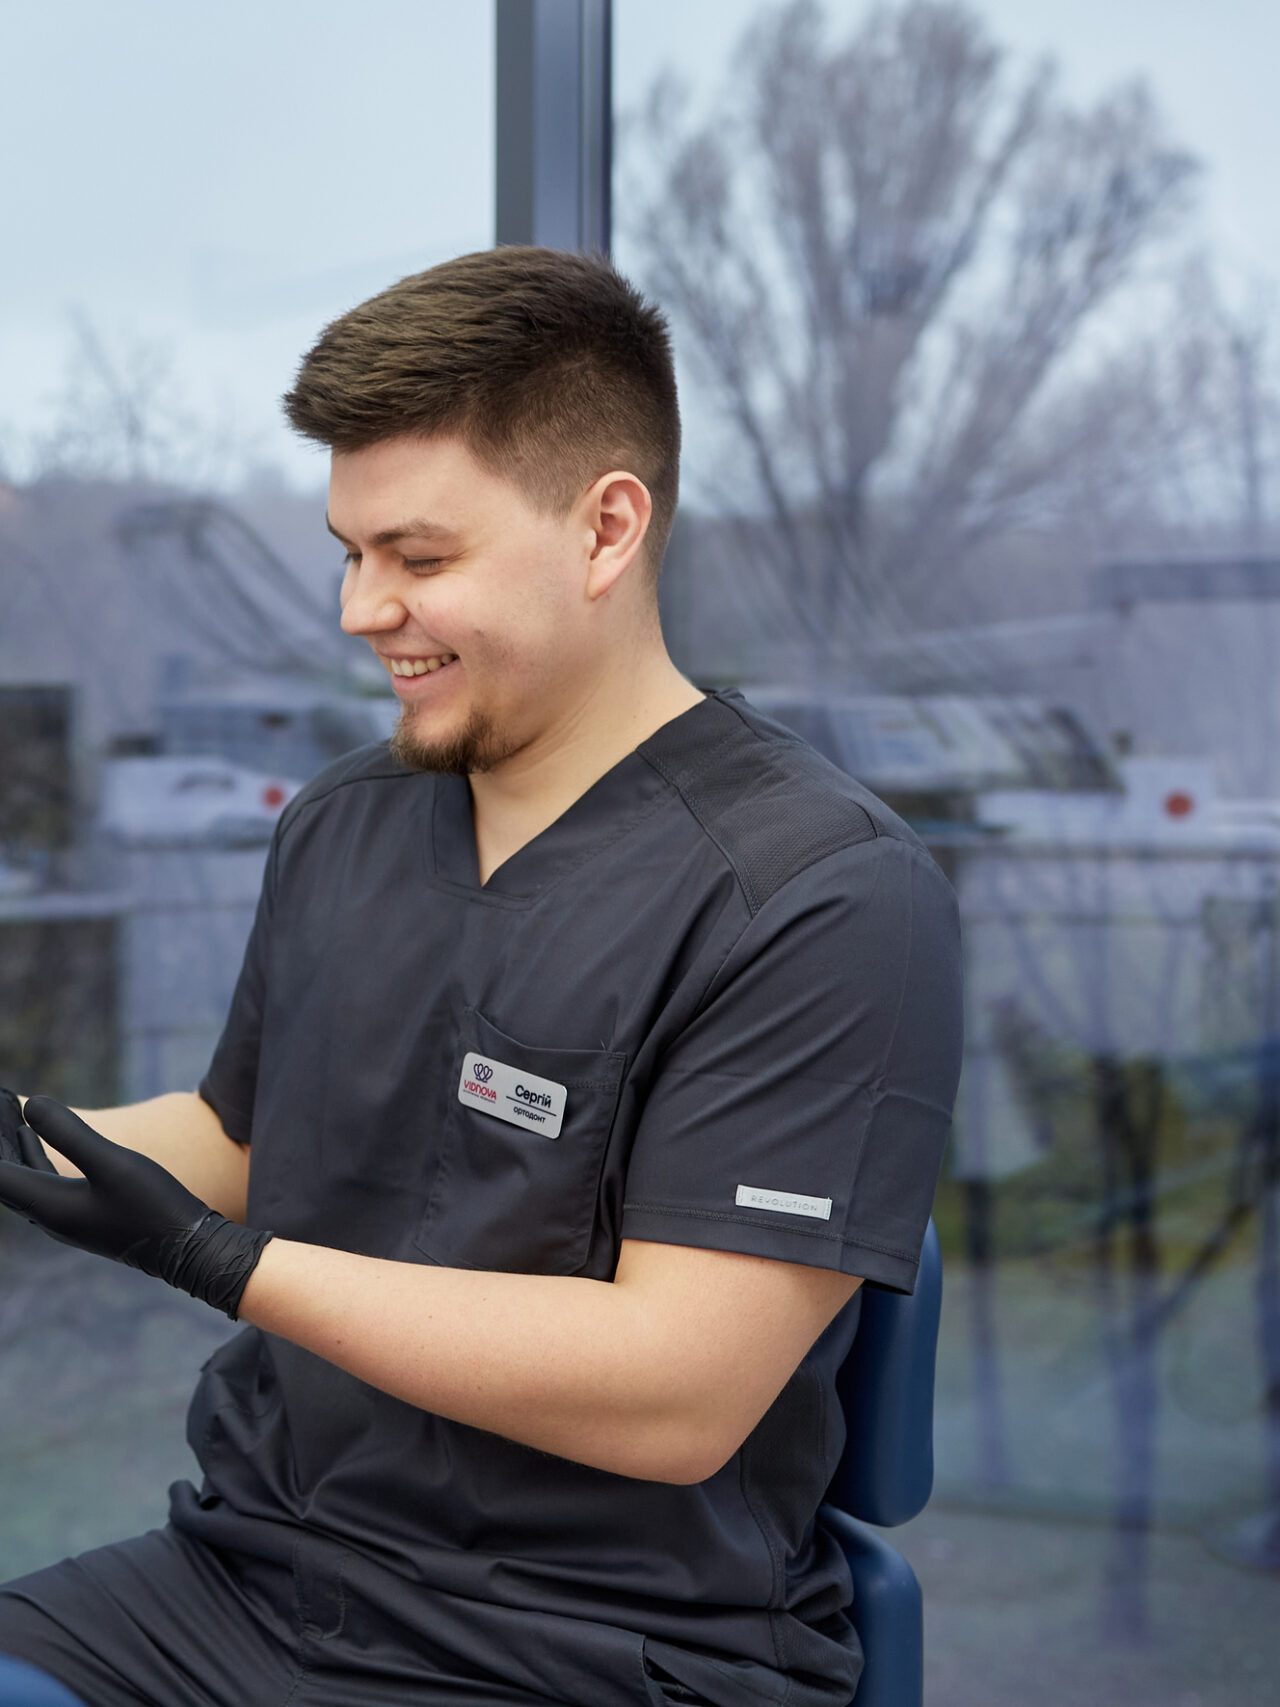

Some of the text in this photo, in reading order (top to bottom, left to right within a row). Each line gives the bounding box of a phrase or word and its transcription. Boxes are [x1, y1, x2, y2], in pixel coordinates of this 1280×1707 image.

[464, 1079, 497, 1100] VIDNOVA
[515, 1085, 551, 1108] Сергій
[513, 1106, 546, 1123] ортодонт
[751, 1195, 817, 1211] REVOLUTION
